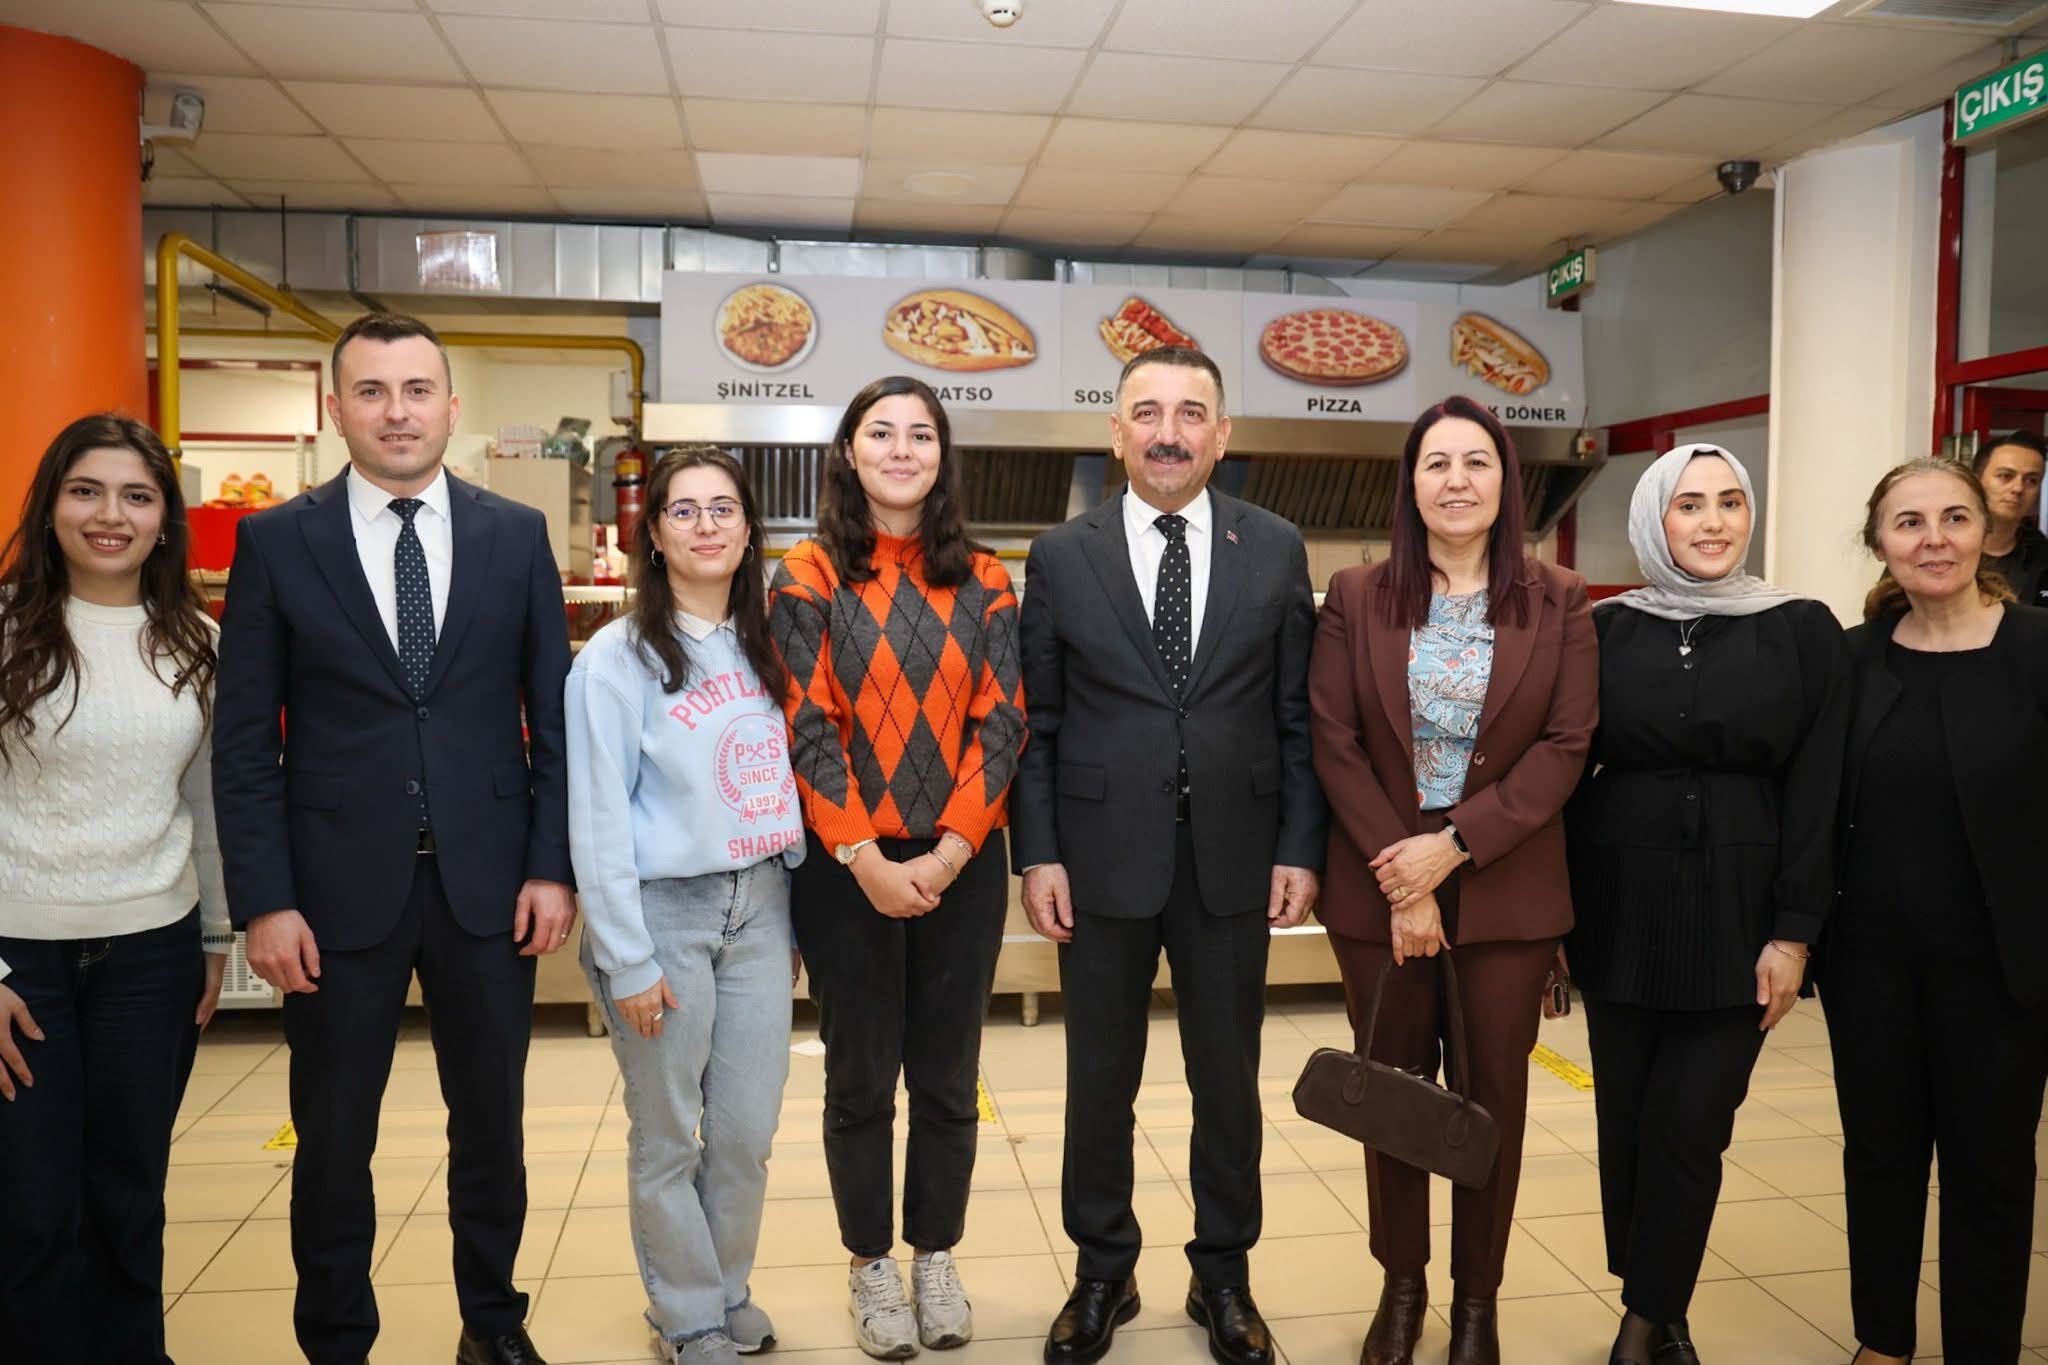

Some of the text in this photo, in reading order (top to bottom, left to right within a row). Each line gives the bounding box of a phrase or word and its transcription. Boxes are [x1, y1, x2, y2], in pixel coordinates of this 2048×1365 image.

[1960, 63, 2045, 131] ÇIKIŞ
[1551, 256, 1583, 295] ÇIKIŞ
[717, 379, 814, 398] ŞİNİTZEL
[1074, 389, 1114, 404] SOS
[1307, 395, 1362, 413] PİZZA
[740, 767, 779, 785] SINCE
[749, 794, 777, 809] 1997
